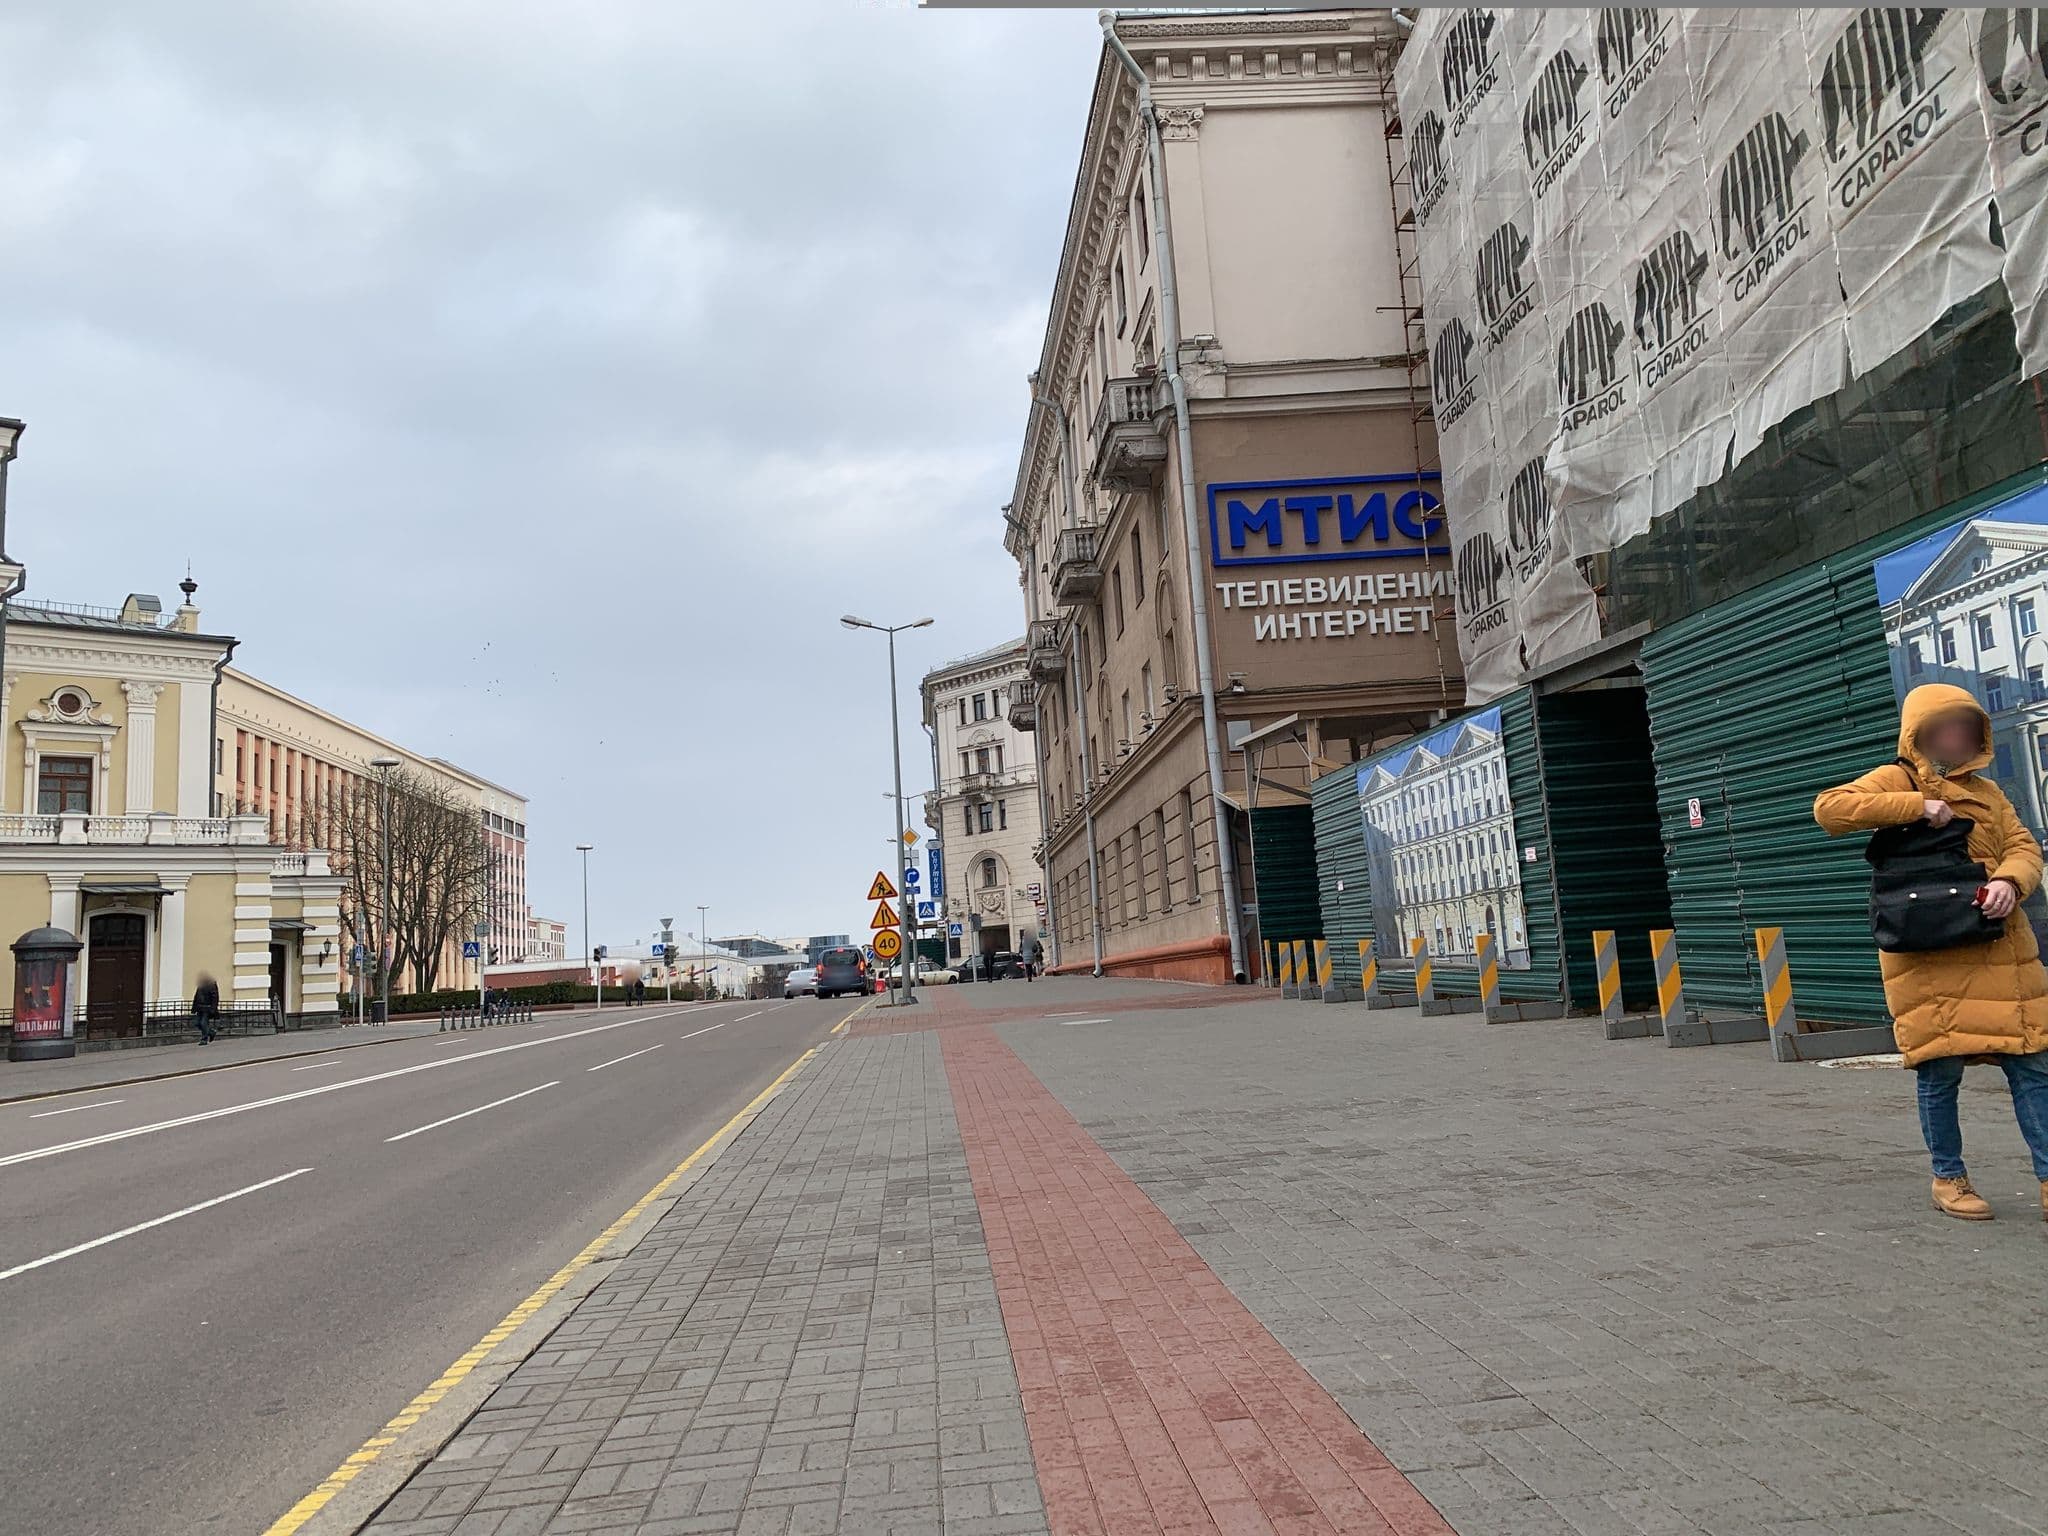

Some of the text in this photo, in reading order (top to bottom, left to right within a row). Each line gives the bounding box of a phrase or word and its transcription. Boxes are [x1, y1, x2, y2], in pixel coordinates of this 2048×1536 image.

[1454, 68, 1499, 138] CAPAROL
[1611, 36, 1669, 119] CAPAROL
[1537, 126, 1586, 199] CAPAROL
[1841, 94, 1948, 209] CAPAROL
[1421, 172, 1449, 228] CAPAROL
[1734, 216, 1810, 302] CAPAROL
[1646, 332, 1710, 389] CAPAROL
[1441, 386, 1477, 433] CAPAROL
[1227, 490, 1443, 549] МТИС
[1254, 605, 1434, 642] ИНТЕРНЕТ
[879, 937, 896, 950] 40
